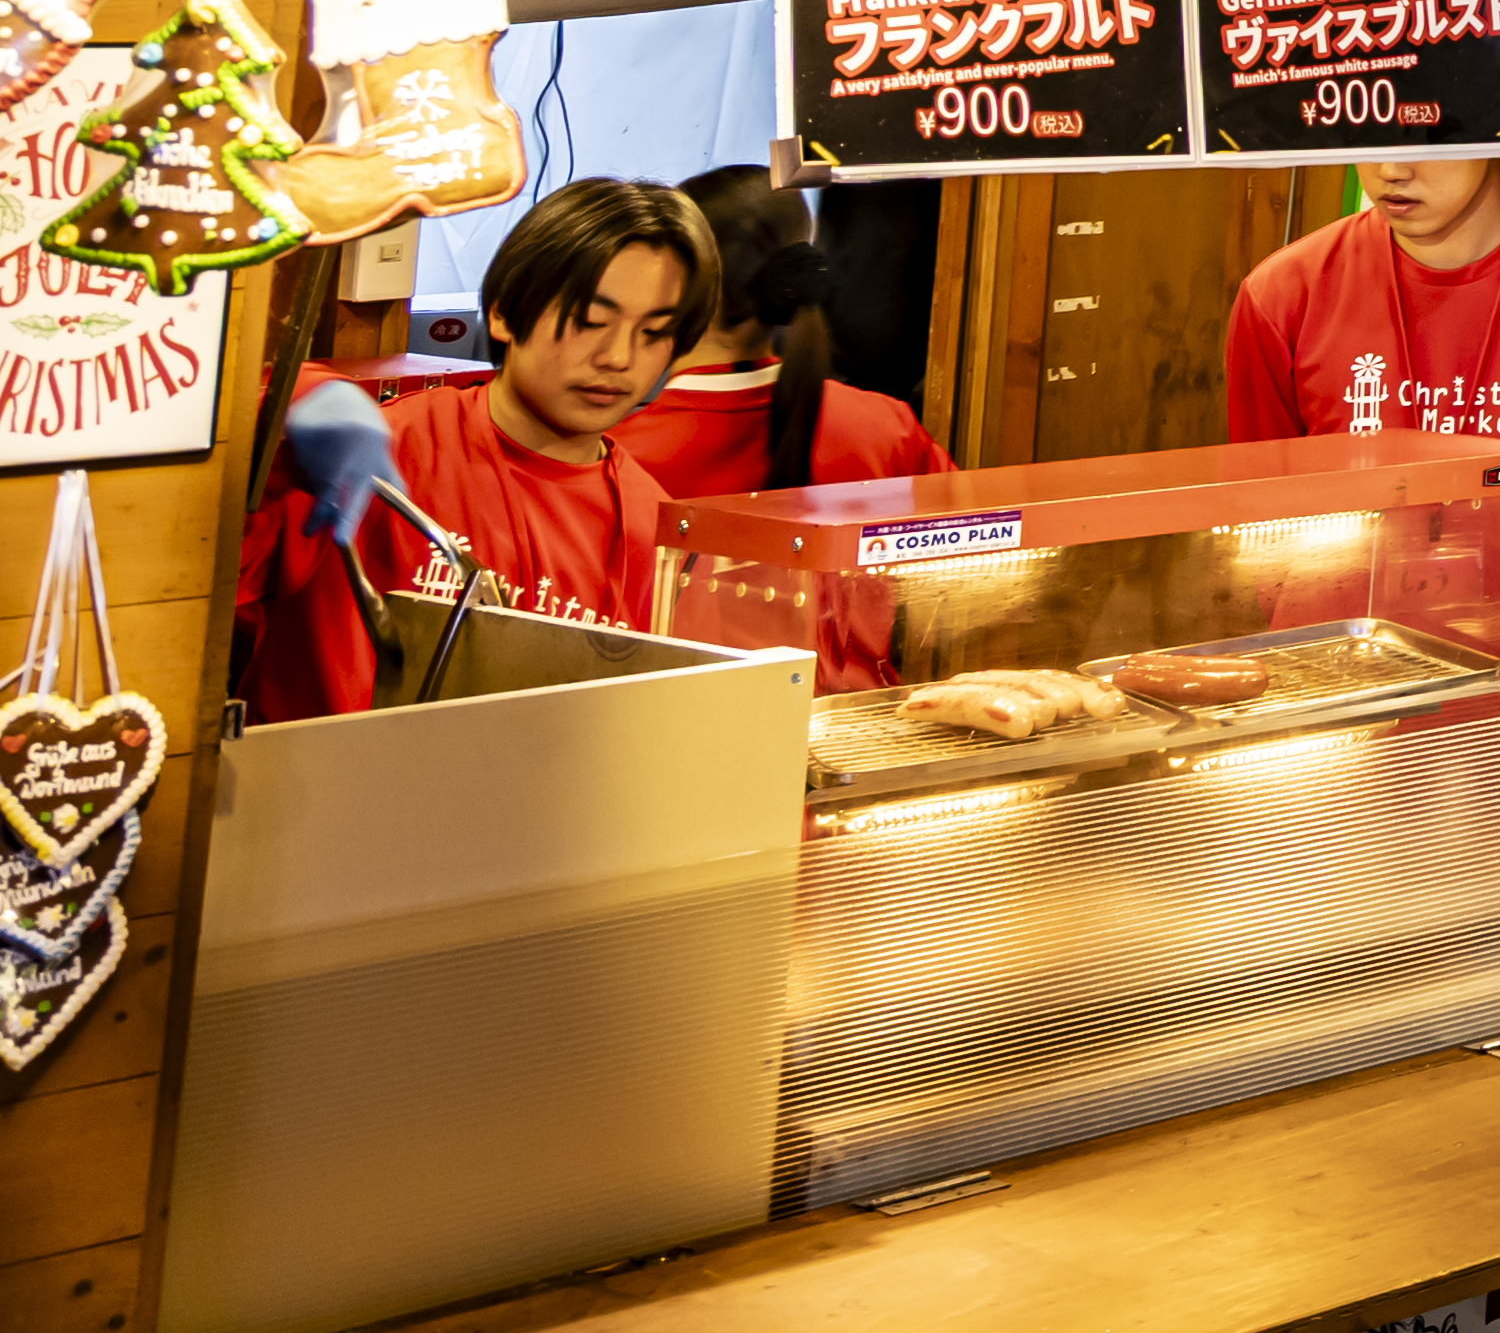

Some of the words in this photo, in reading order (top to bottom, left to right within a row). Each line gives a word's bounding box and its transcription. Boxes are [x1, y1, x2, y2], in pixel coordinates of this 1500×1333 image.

[847, 78, 881, 95] very
[883, 70, 953, 88] satisfying
[955, 65, 982, 80] and
[984, 56, 1070, 78] ever-popular
[1073, 54, 1114, 68] menu.
[1235, 68, 1288, 86] Munich's
[1290, 64, 1333, 79] famous
[1335, 61, 1369, 75] white
[1371, 55, 1418, 70] sausage
[919, 85, 1030, 137] ¥900
[1303, 80, 1396, 125] ¥900
[0, 317, 200, 438] RISTMAS
[896, 532, 960, 549] COSMO
[968, 526, 1013, 542] PLAN
[27, 740, 79, 779] Grüße
[81, 741, 117, 762] aus
[14, 760, 125, 800] Dortmund
